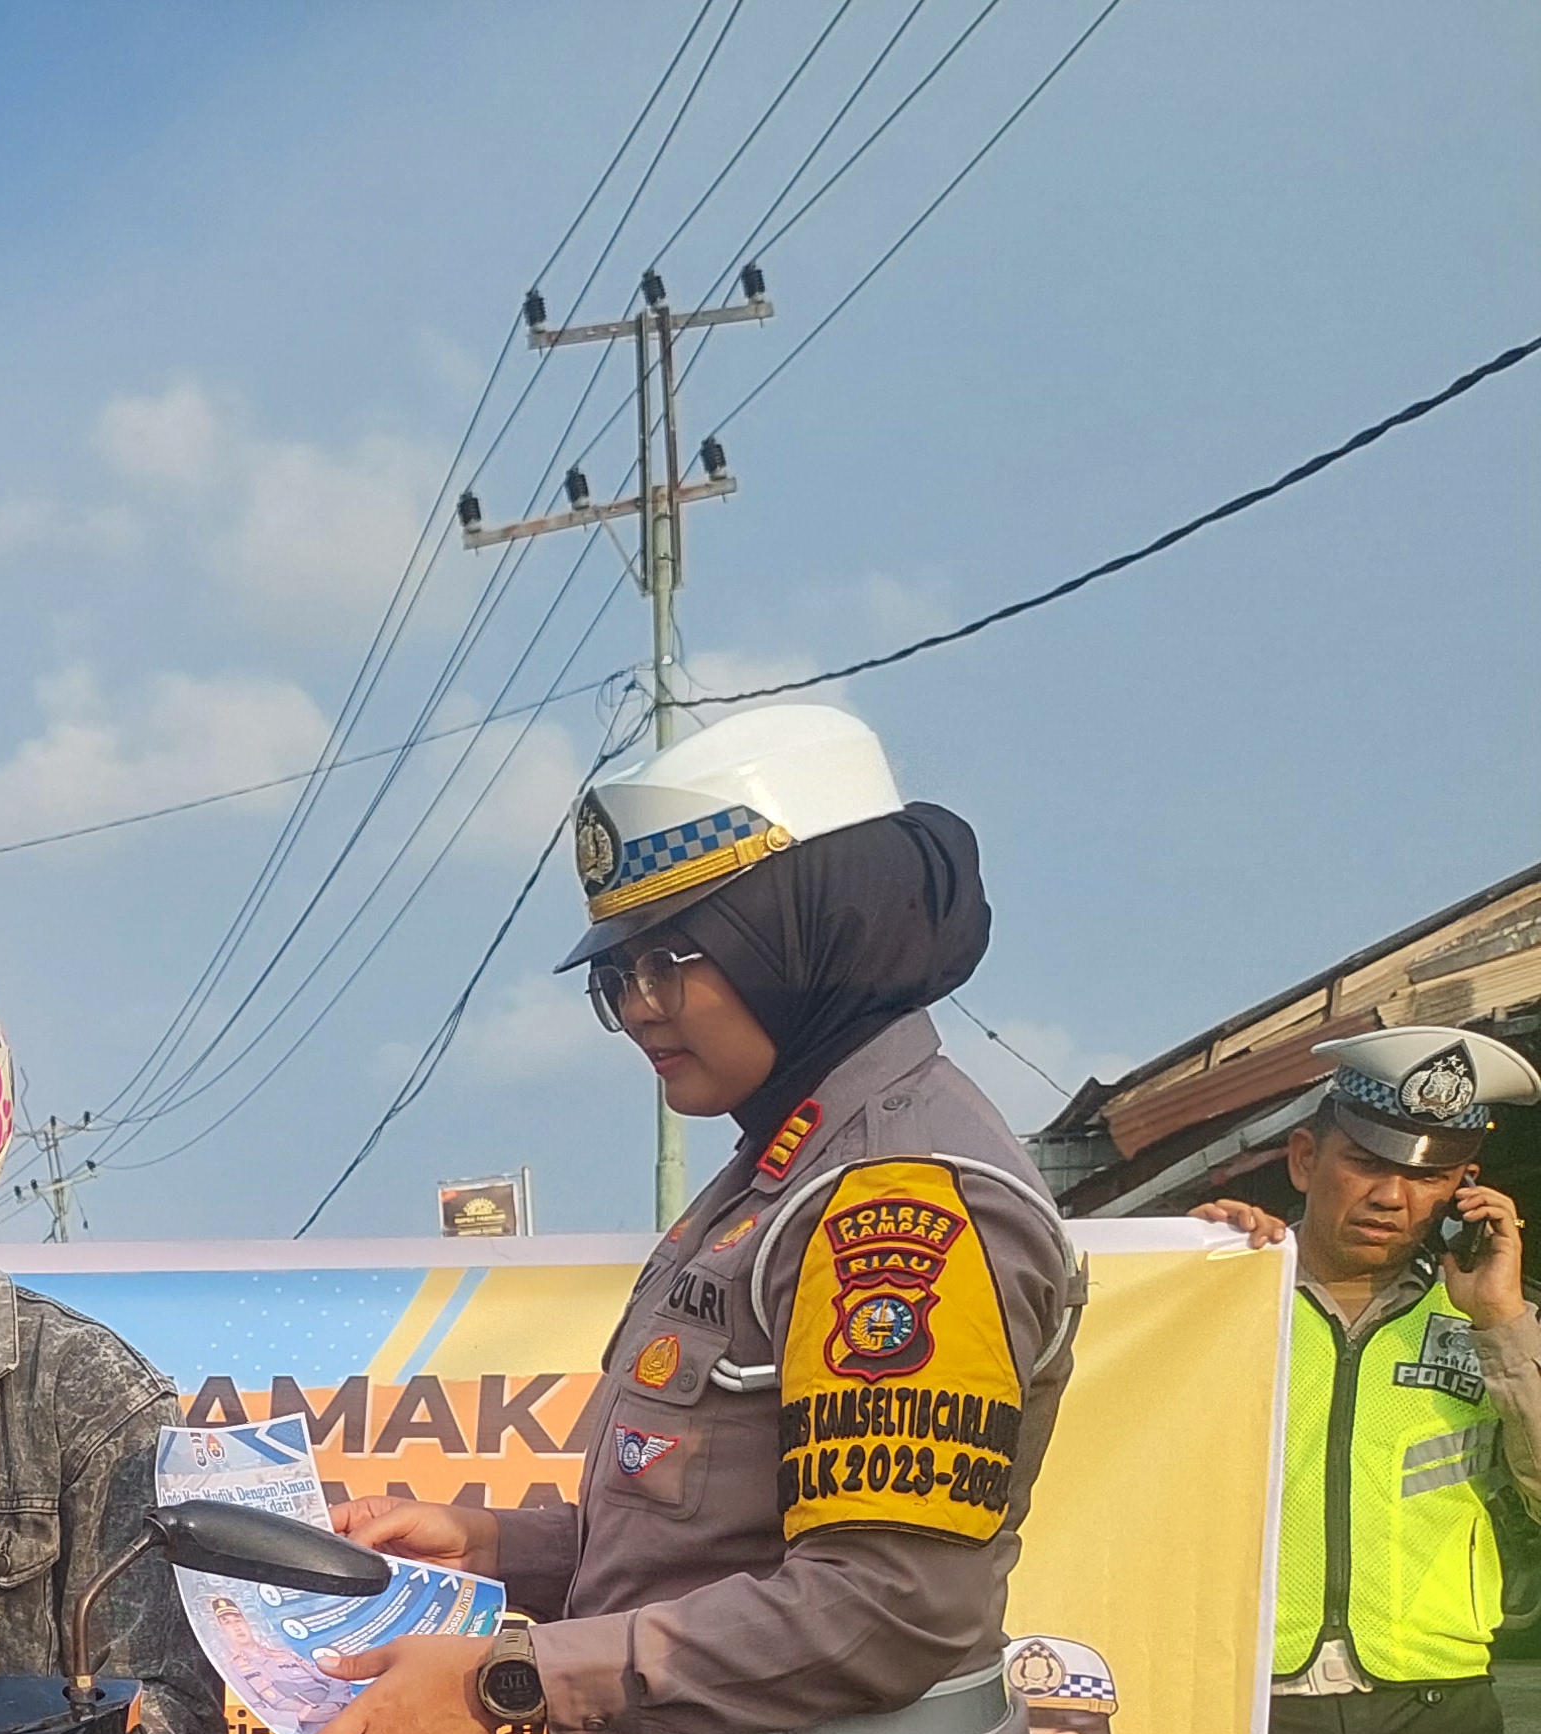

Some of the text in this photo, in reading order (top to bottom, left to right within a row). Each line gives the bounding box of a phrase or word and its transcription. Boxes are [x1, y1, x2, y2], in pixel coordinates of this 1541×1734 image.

[838, 1205, 951, 1235] POLRES
[842, 1220, 944, 1244] KAMPAR
[848, 1253, 932, 1273] RIAU
[669, 1270, 726, 1327] OLRI
[168, 1374, 609, 1455] AMAK
[235, 1483, 278, 1503] Dengan
[279, 1477, 315, 1496] Aman
